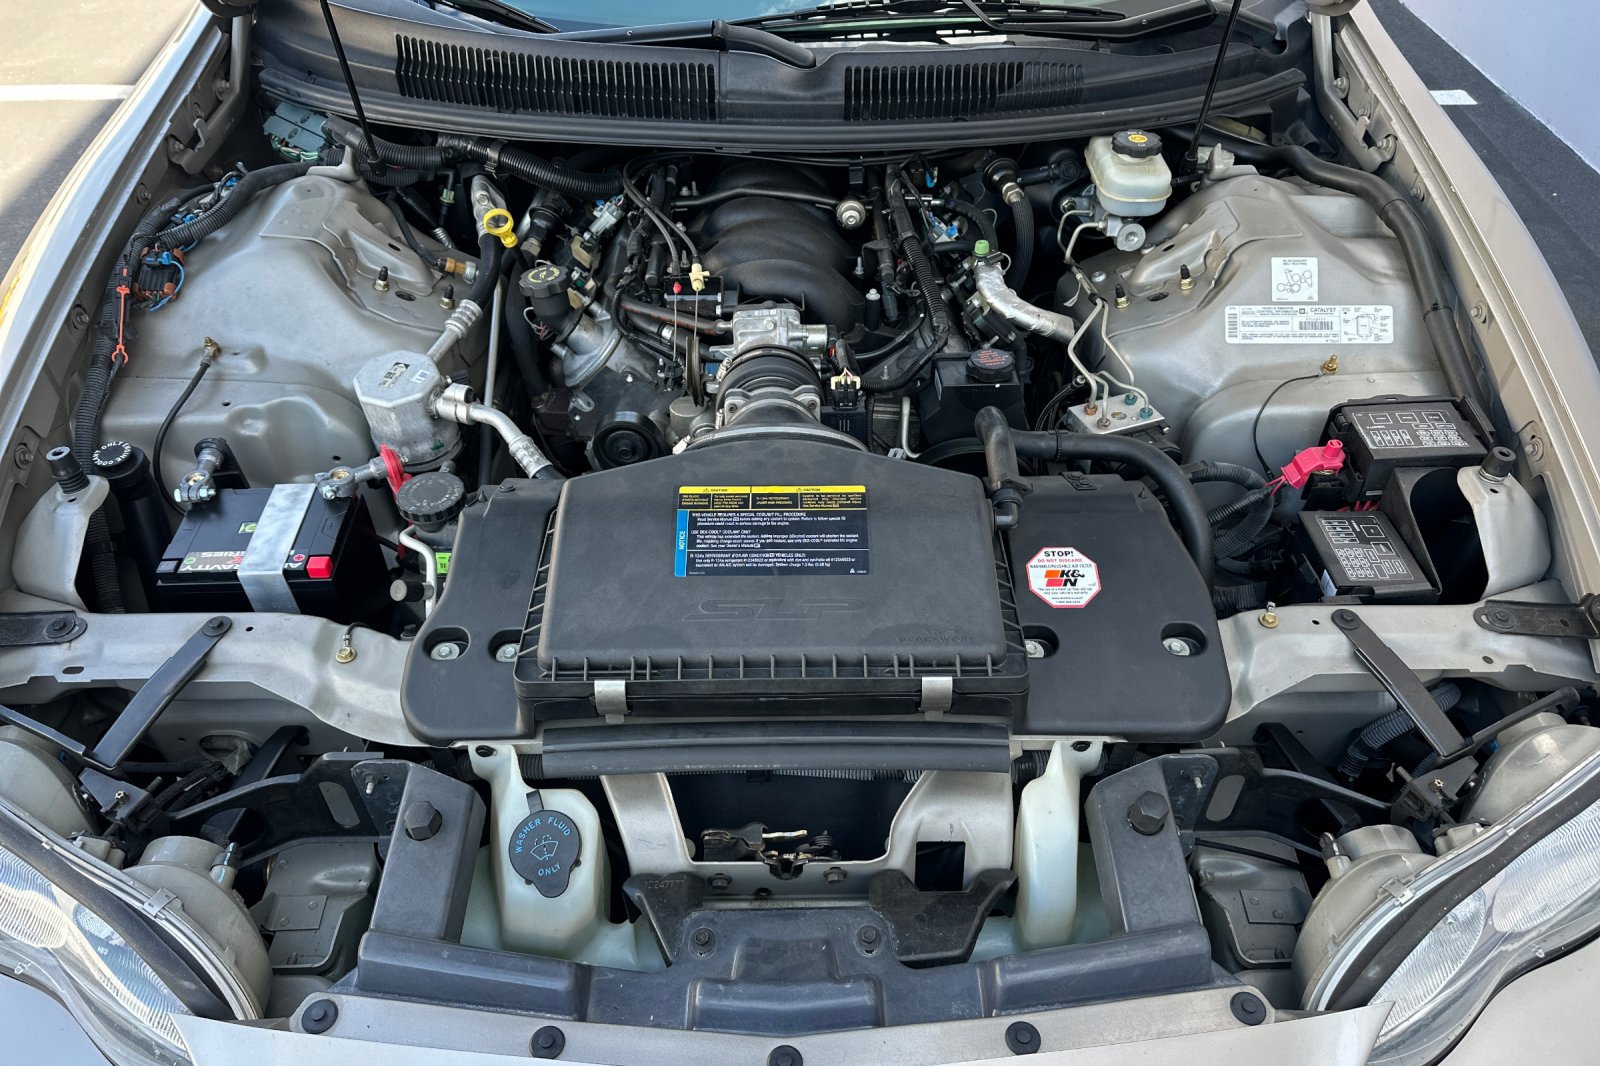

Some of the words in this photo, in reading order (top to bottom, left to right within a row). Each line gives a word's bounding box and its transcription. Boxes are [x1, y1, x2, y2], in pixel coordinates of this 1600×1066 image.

[101, 441, 123, 450] ONLY
[1063, 579, 1078, 587] N
[515, 818, 541, 854] WASHER
[548, 816, 571, 836] FLUID
[538, 862, 560, 876] ONLY
